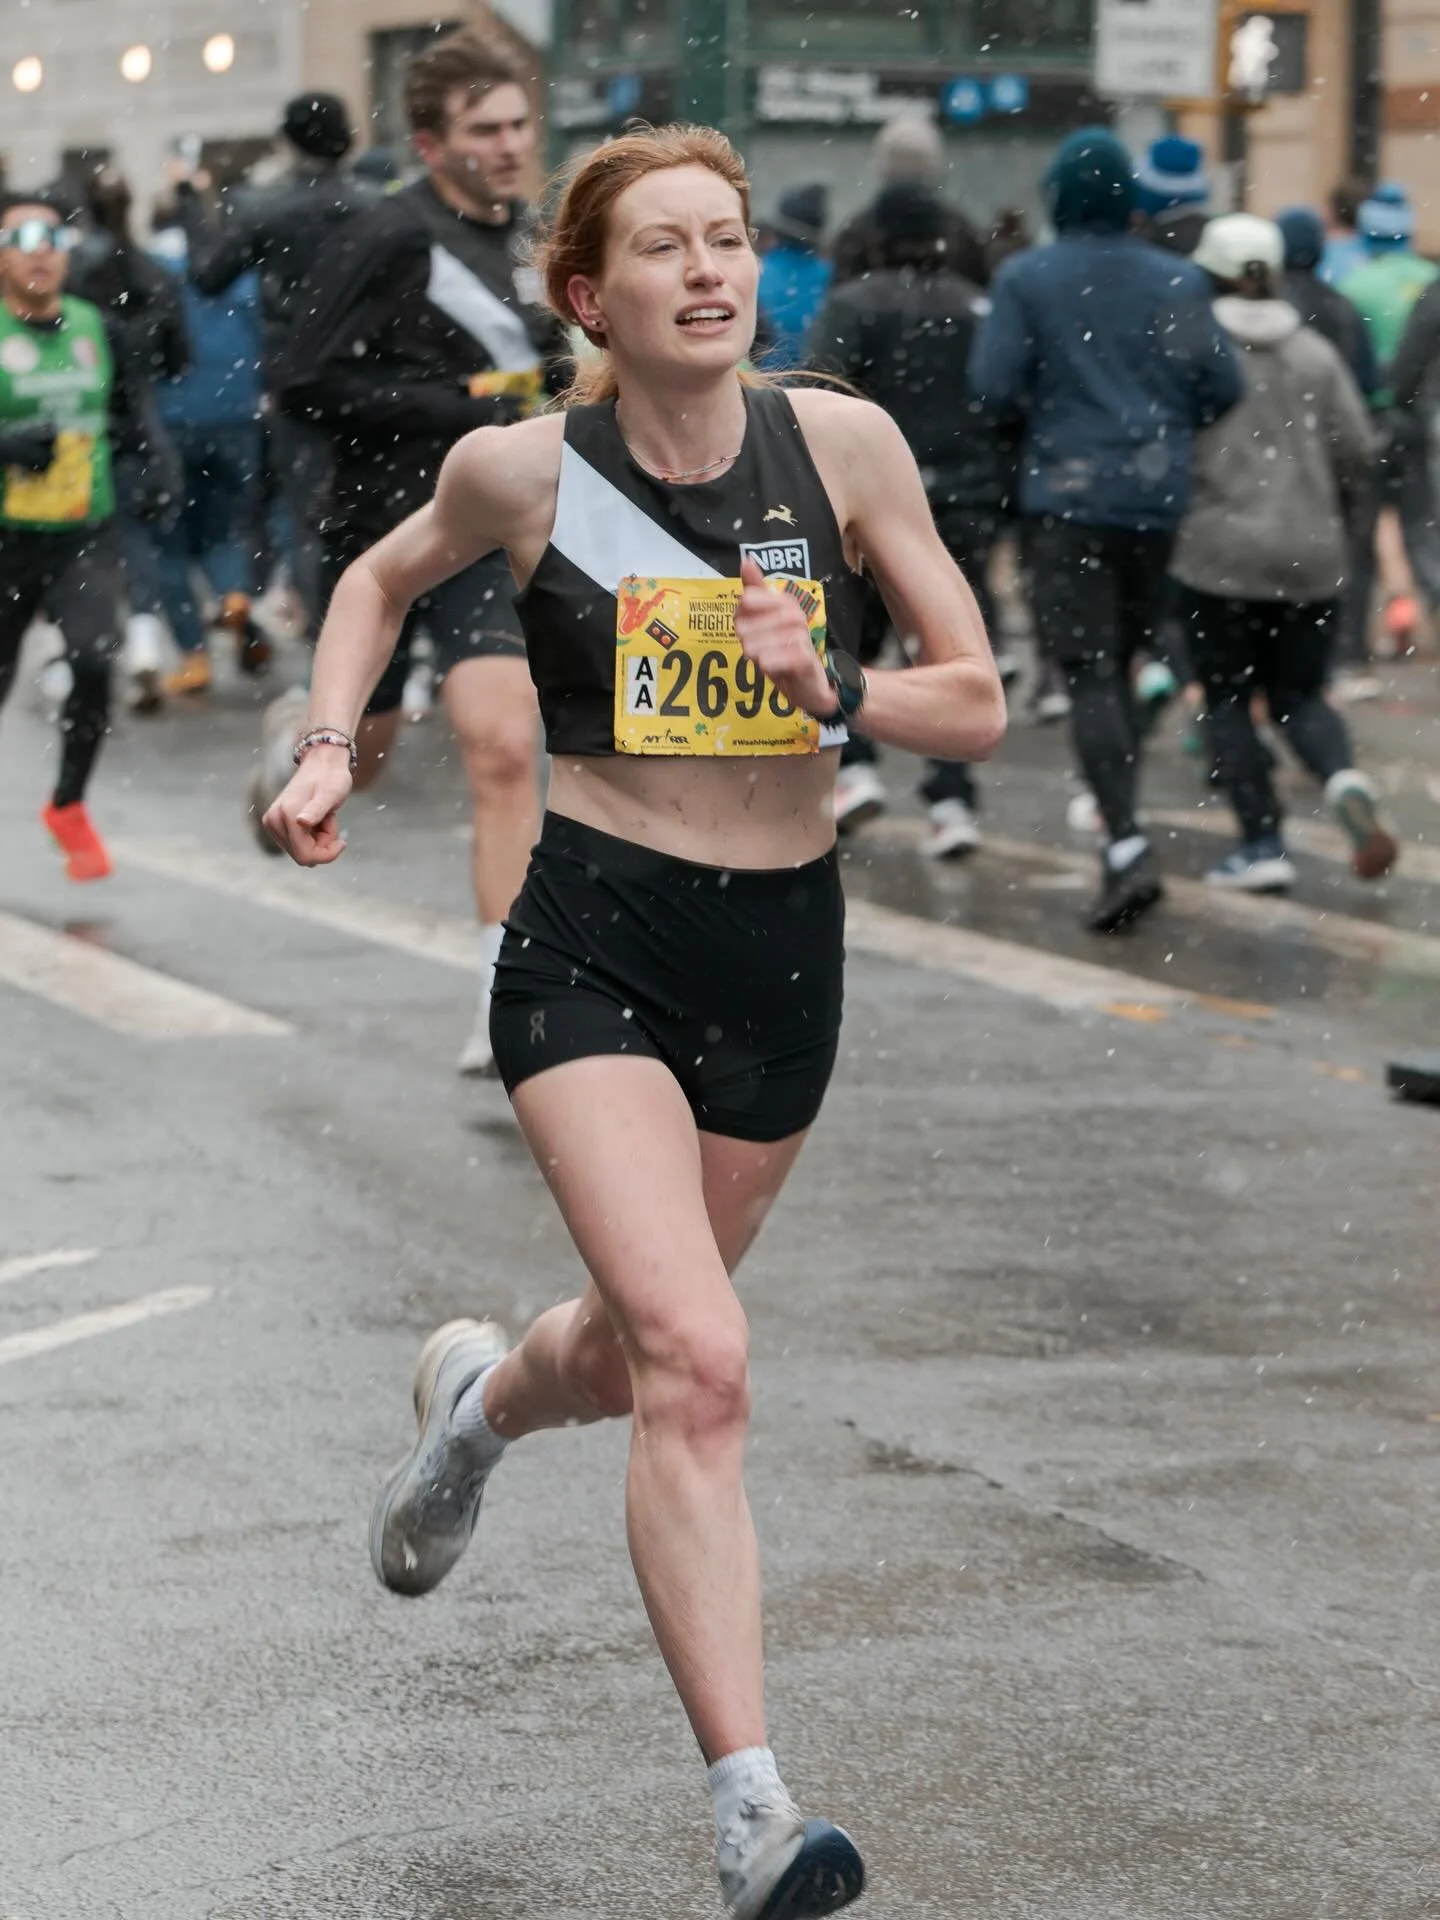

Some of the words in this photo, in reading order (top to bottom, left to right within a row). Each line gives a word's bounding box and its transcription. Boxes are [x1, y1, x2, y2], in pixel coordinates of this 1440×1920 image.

[748, 547, 803, 571] NBR
[688, 602, 738, 613] WASHINGTO
[635, 656, 654, 681] A
[635, 684, 653, 709] A
